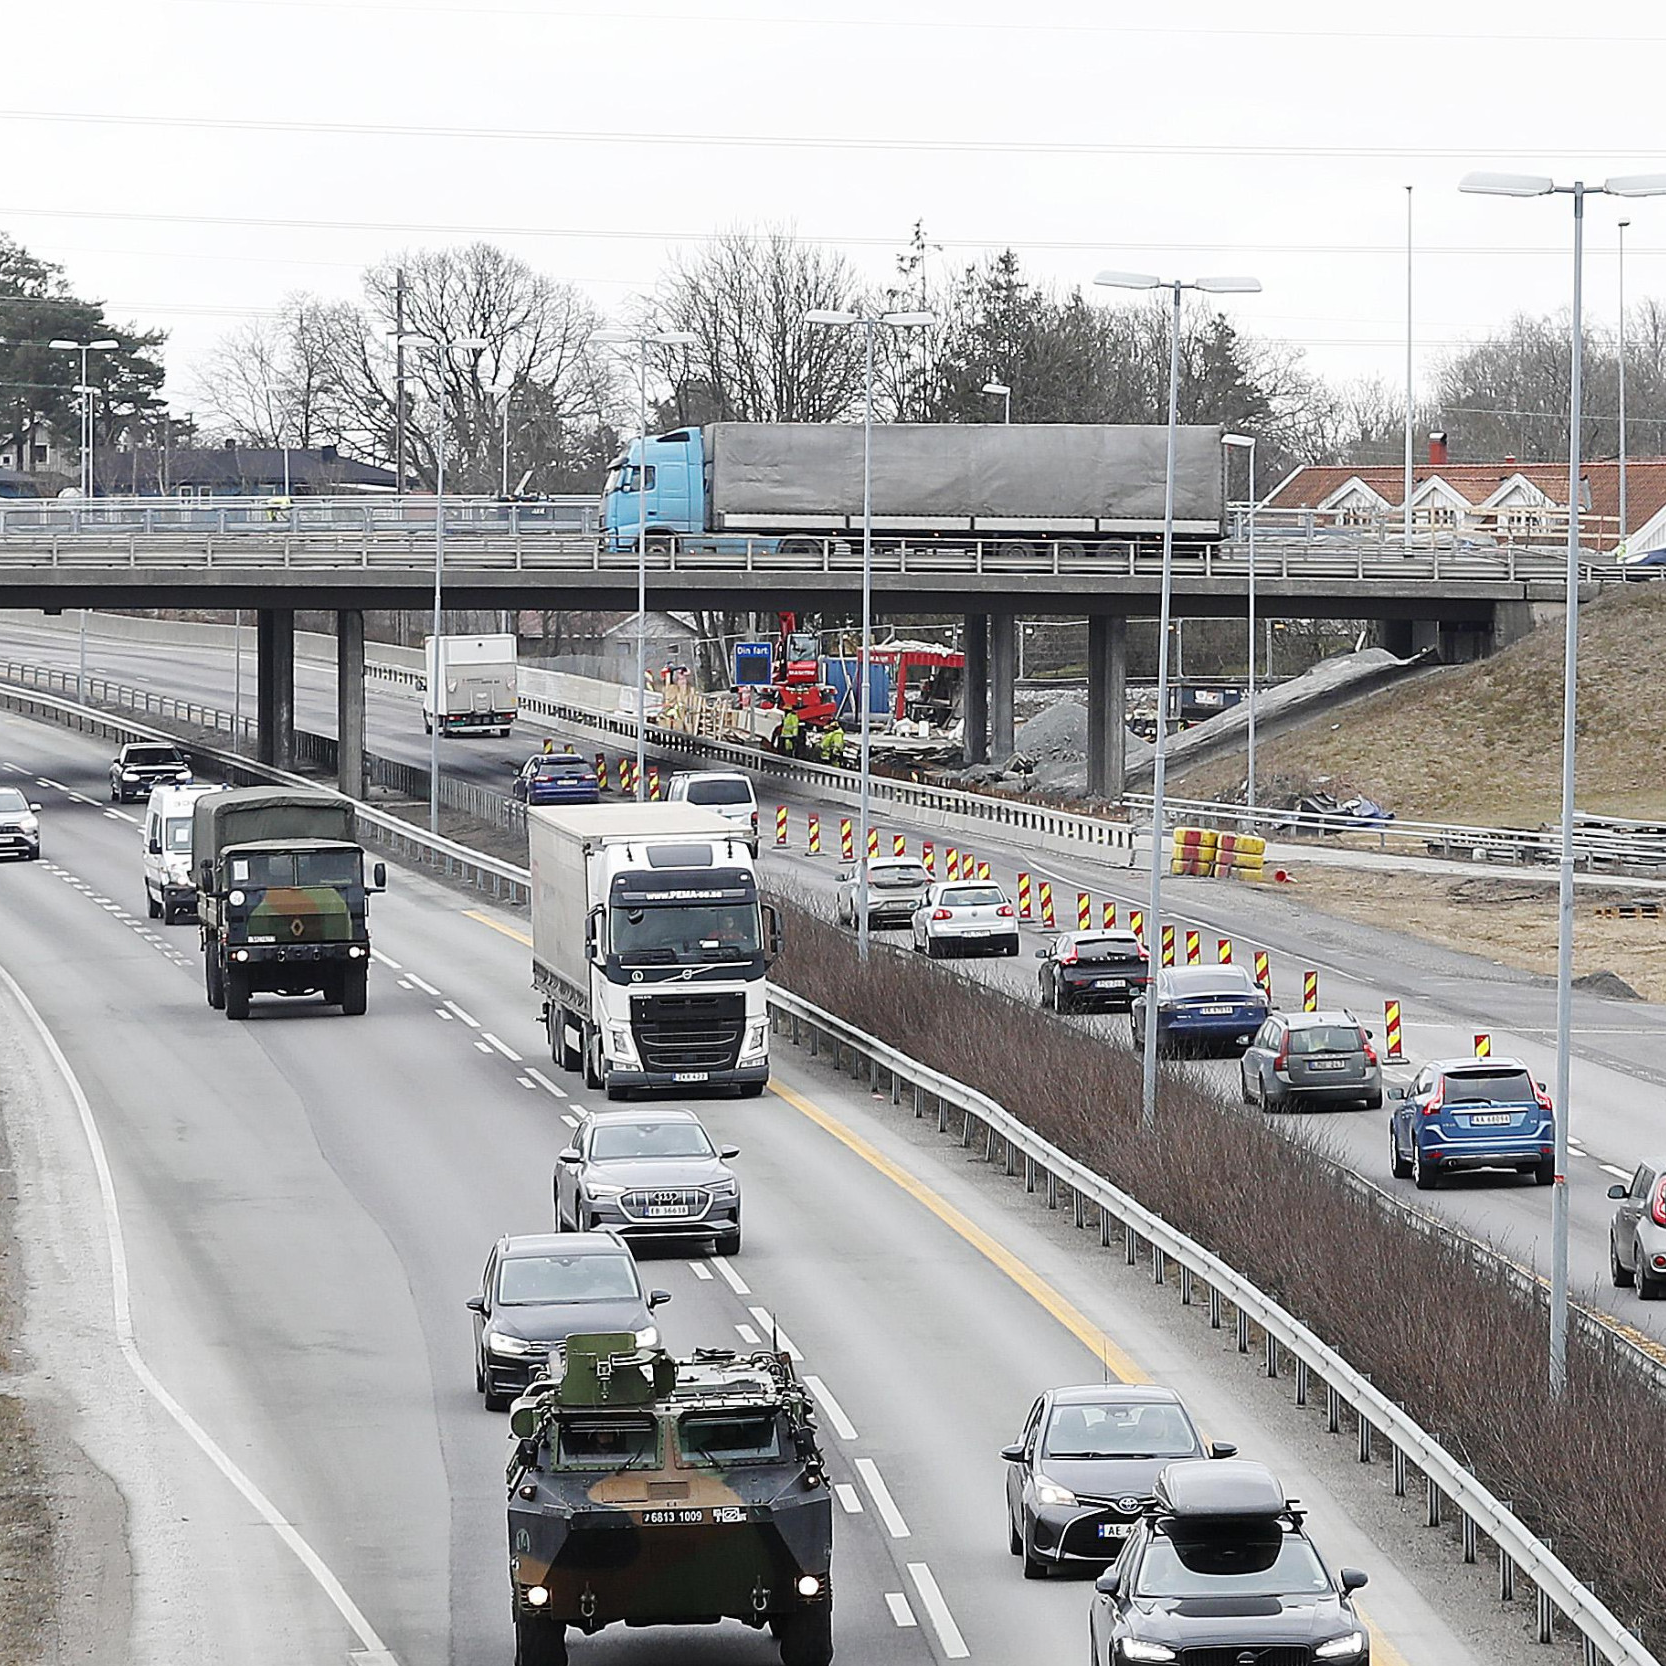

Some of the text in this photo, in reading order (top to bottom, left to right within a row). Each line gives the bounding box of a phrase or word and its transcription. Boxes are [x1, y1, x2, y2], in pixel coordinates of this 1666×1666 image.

[737, 646, 769, 654] Din fart
[651, 1511, 675, 1523] 6813
[679, 1510, 703, 1522] 1009
[1108, 1526, 1121, 1536] AE
